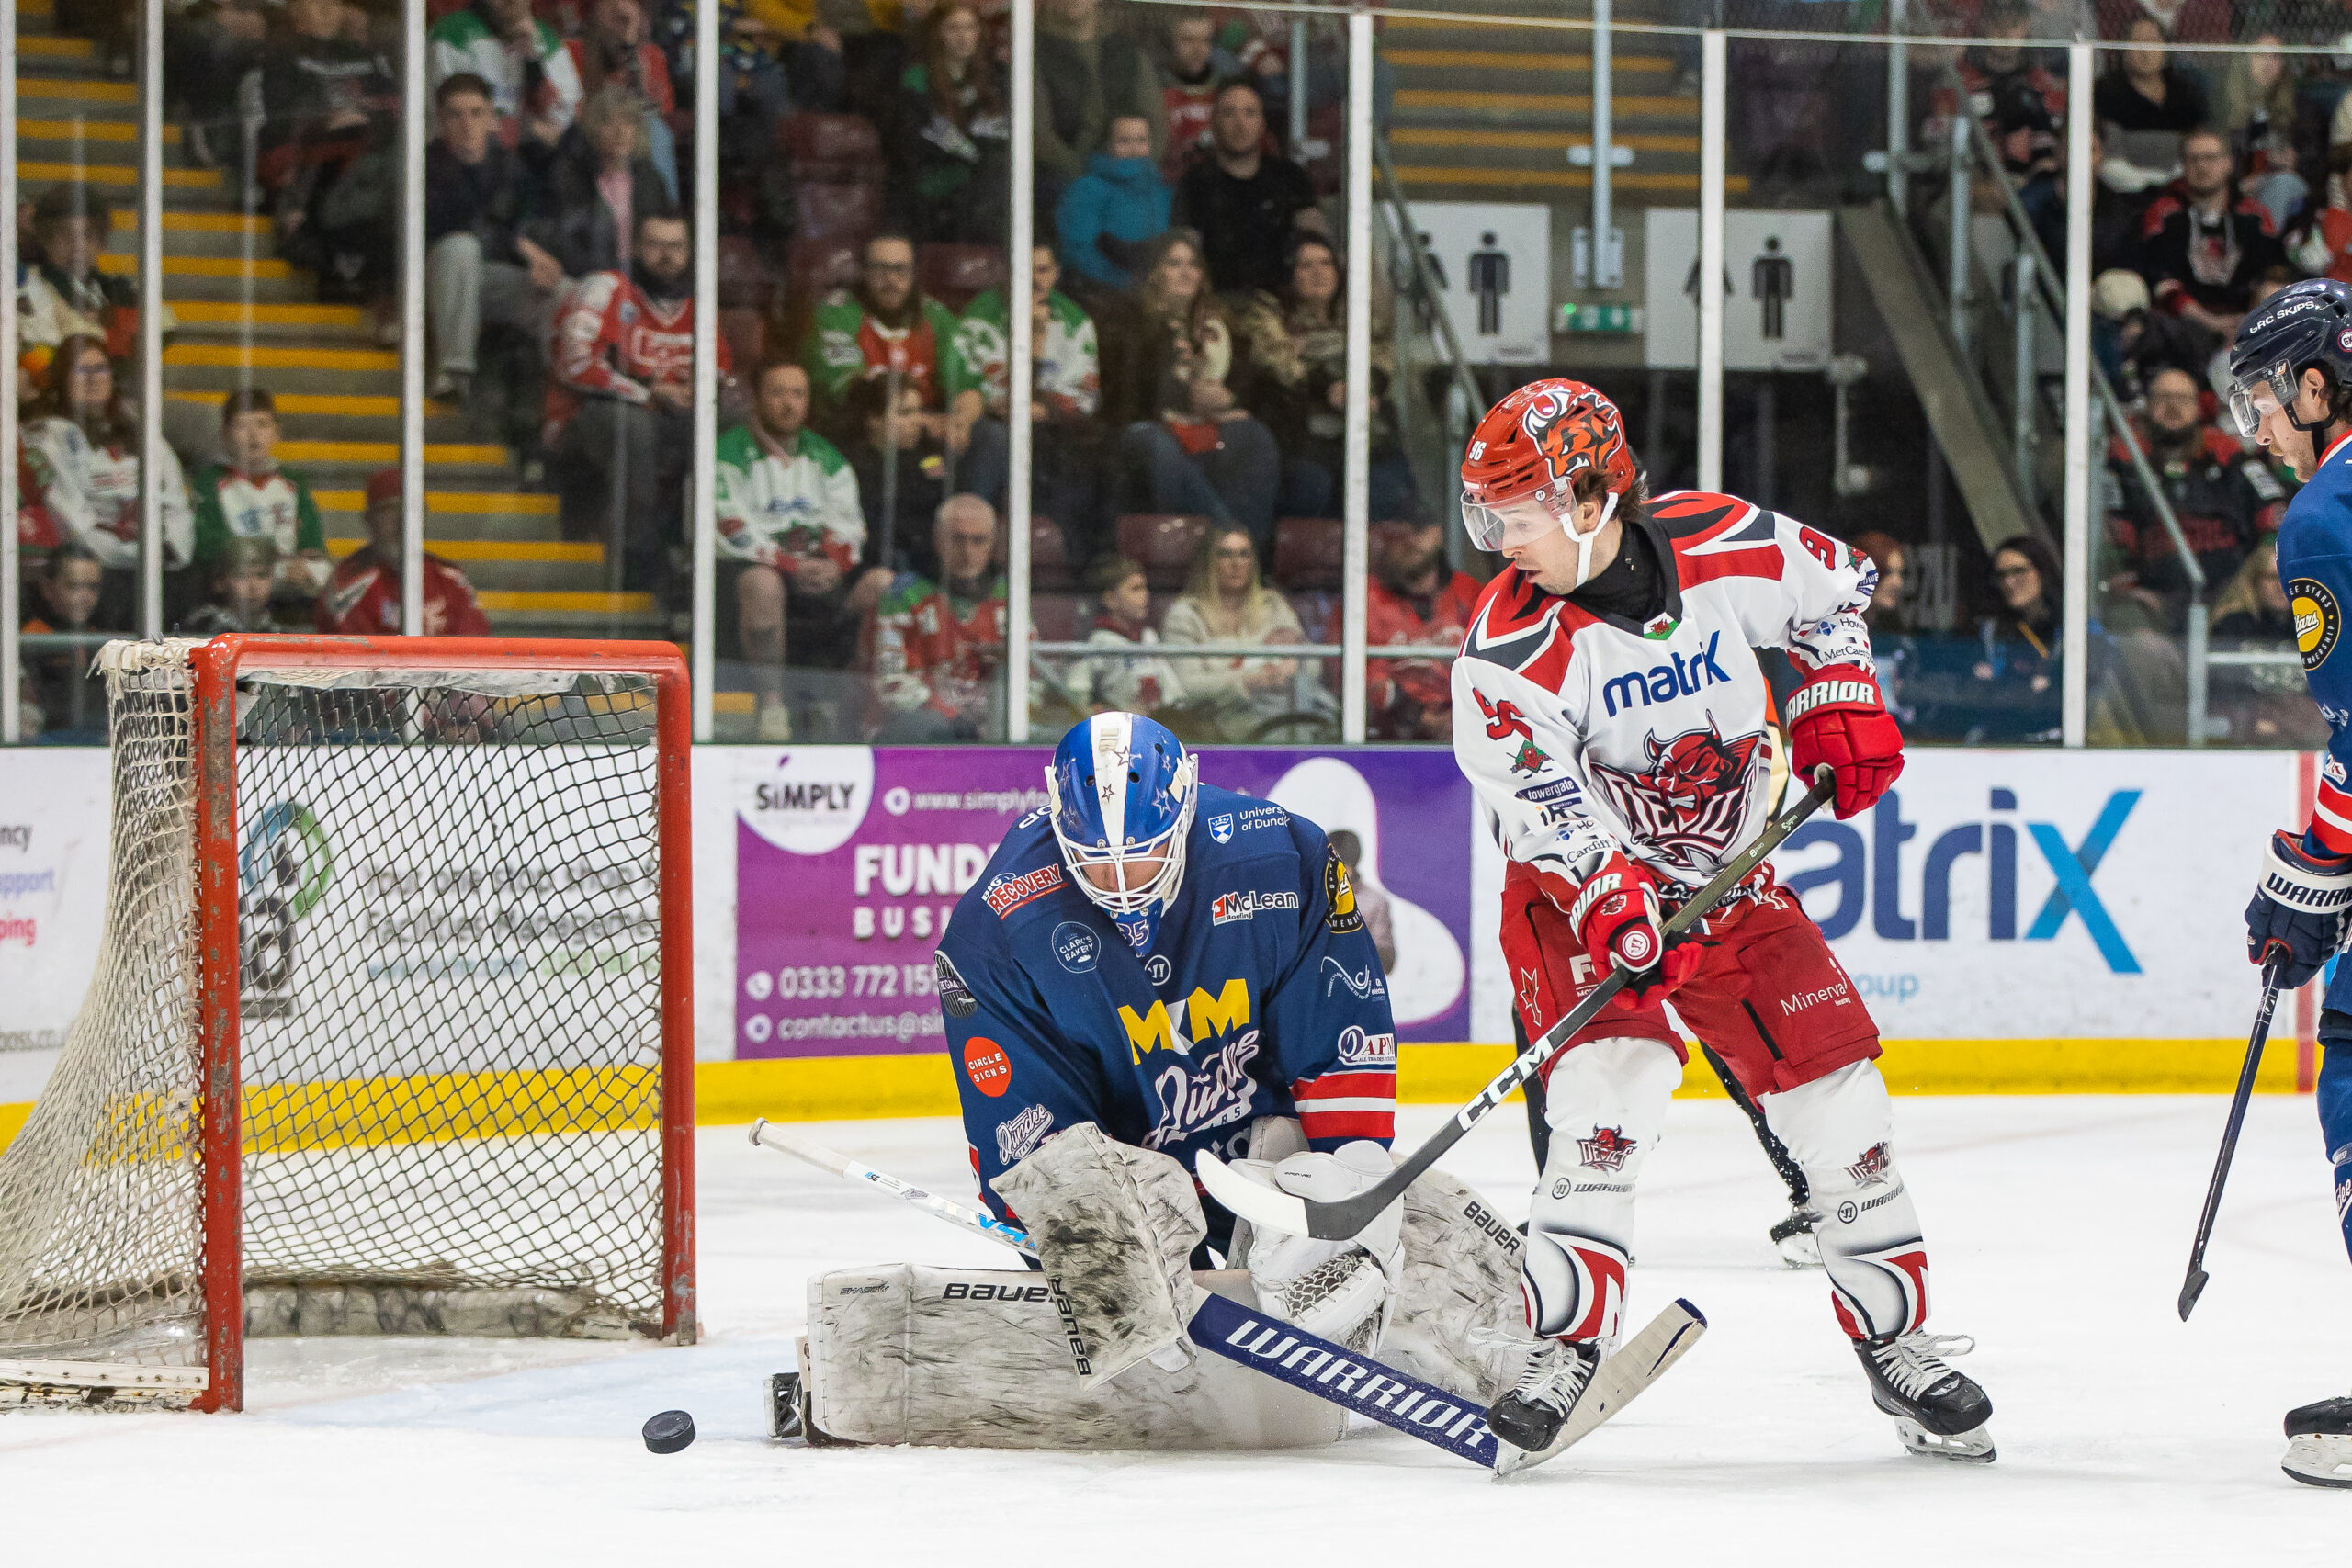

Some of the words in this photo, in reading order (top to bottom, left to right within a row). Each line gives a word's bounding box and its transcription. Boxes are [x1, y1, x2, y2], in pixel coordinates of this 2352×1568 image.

[2277, 300, 2314, 319] SKIPS
[1468, 441, 1487, 461] 96
[1527, 779, 1575, 801] towergate
[1242, 820, 1253, 831] of
[1567, 839, 1611, 863] Cardiff
[987, 864, 1063, 916] RECOVERY
[1225, 891, 1298, 916] McLean
[1059, 936, 1092, 954] CLARK'S
[1065, 943, 1093, 962] BAKERY
[779, 965, 845, 999] 0333
[851, 965, 899, 998] 772
[1780, 983, 1847, 1016] Minerva
[1117, 978, 1250, 1066] MKM
[968, 1052, 1002, 1070] CIRCLE
[973, 1065, 1008, 1083] SIGNS
[1457, 1034, 1554, 1131] CCM
[1225, 1319, 1493, 1449] WARRIOR
